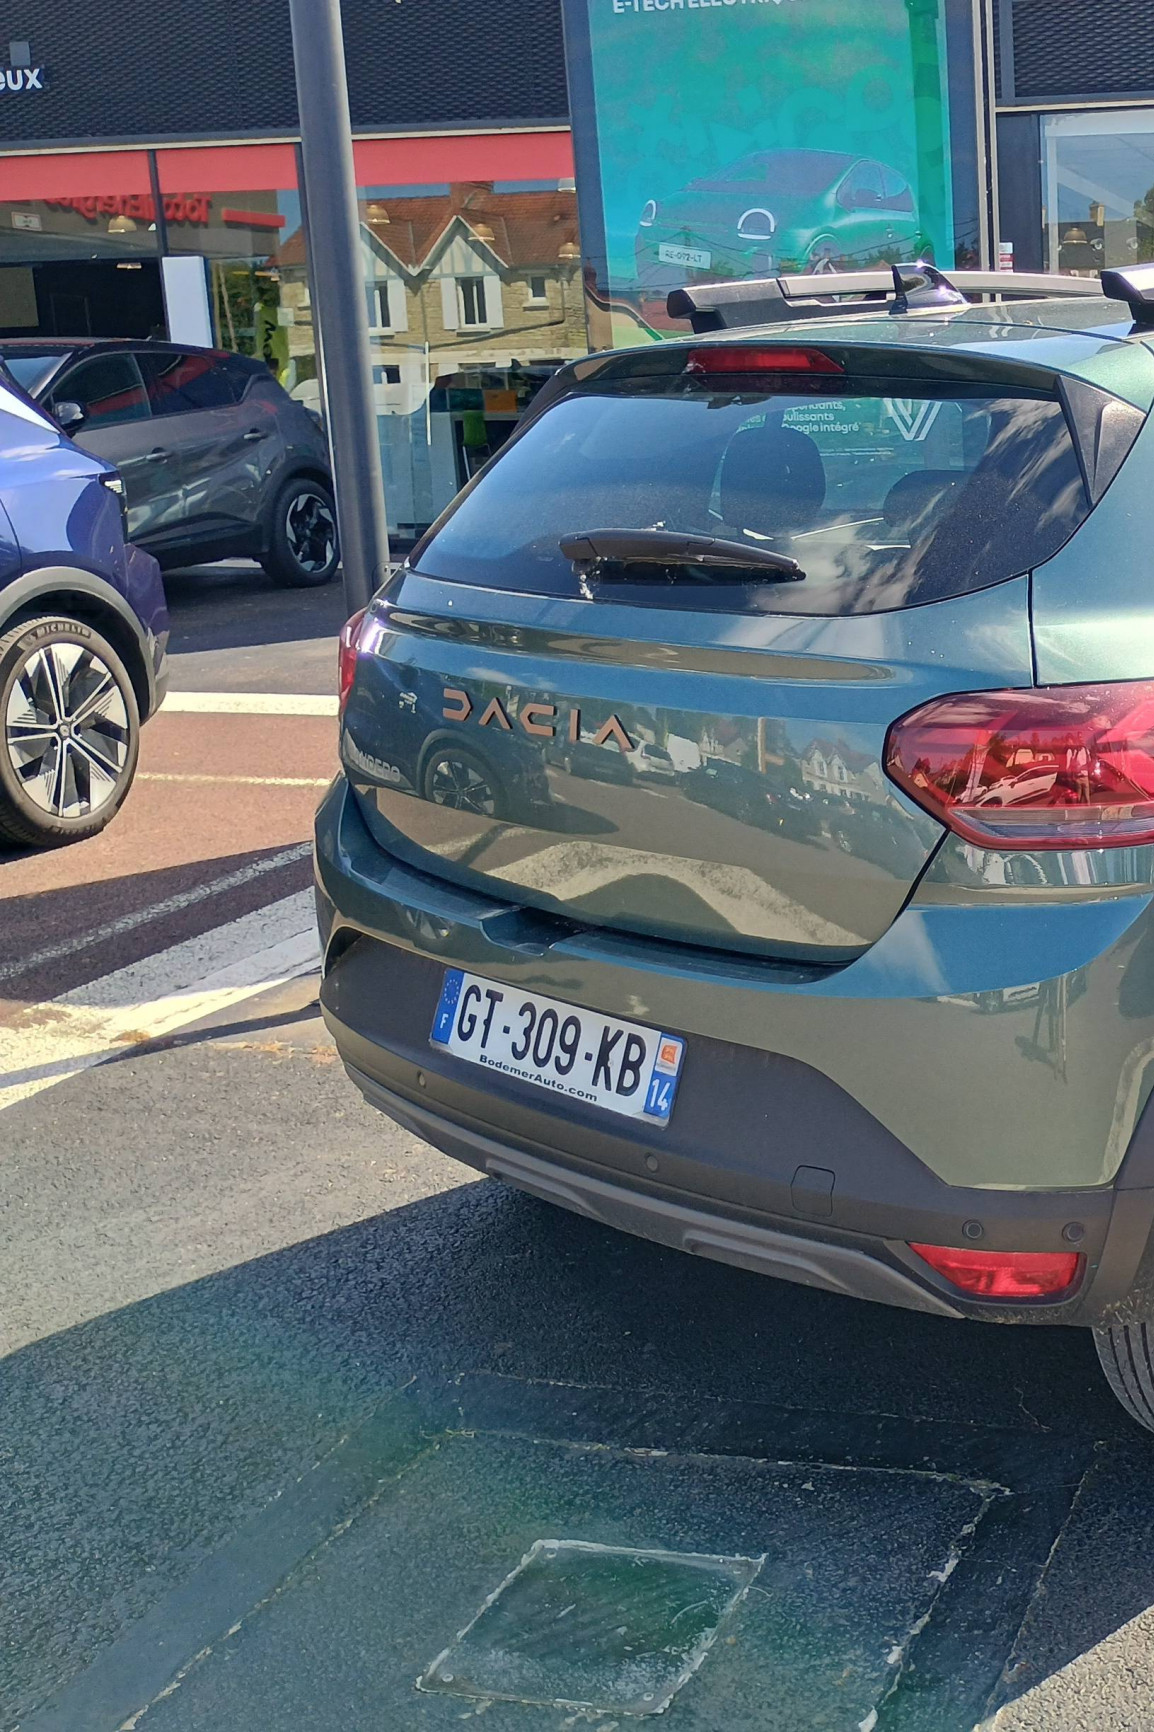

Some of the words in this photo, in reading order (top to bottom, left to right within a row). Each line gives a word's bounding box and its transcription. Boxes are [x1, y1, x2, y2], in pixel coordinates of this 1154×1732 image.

[443, 688, 635, 750] DACIA
[439, 1013, 449, 1029] F
[457, 984, 646, 1097] GT-309-KB
[479, 1053, 598, 1102] BodemerAuto.com
[650, 1078, 671, 1112] 14
